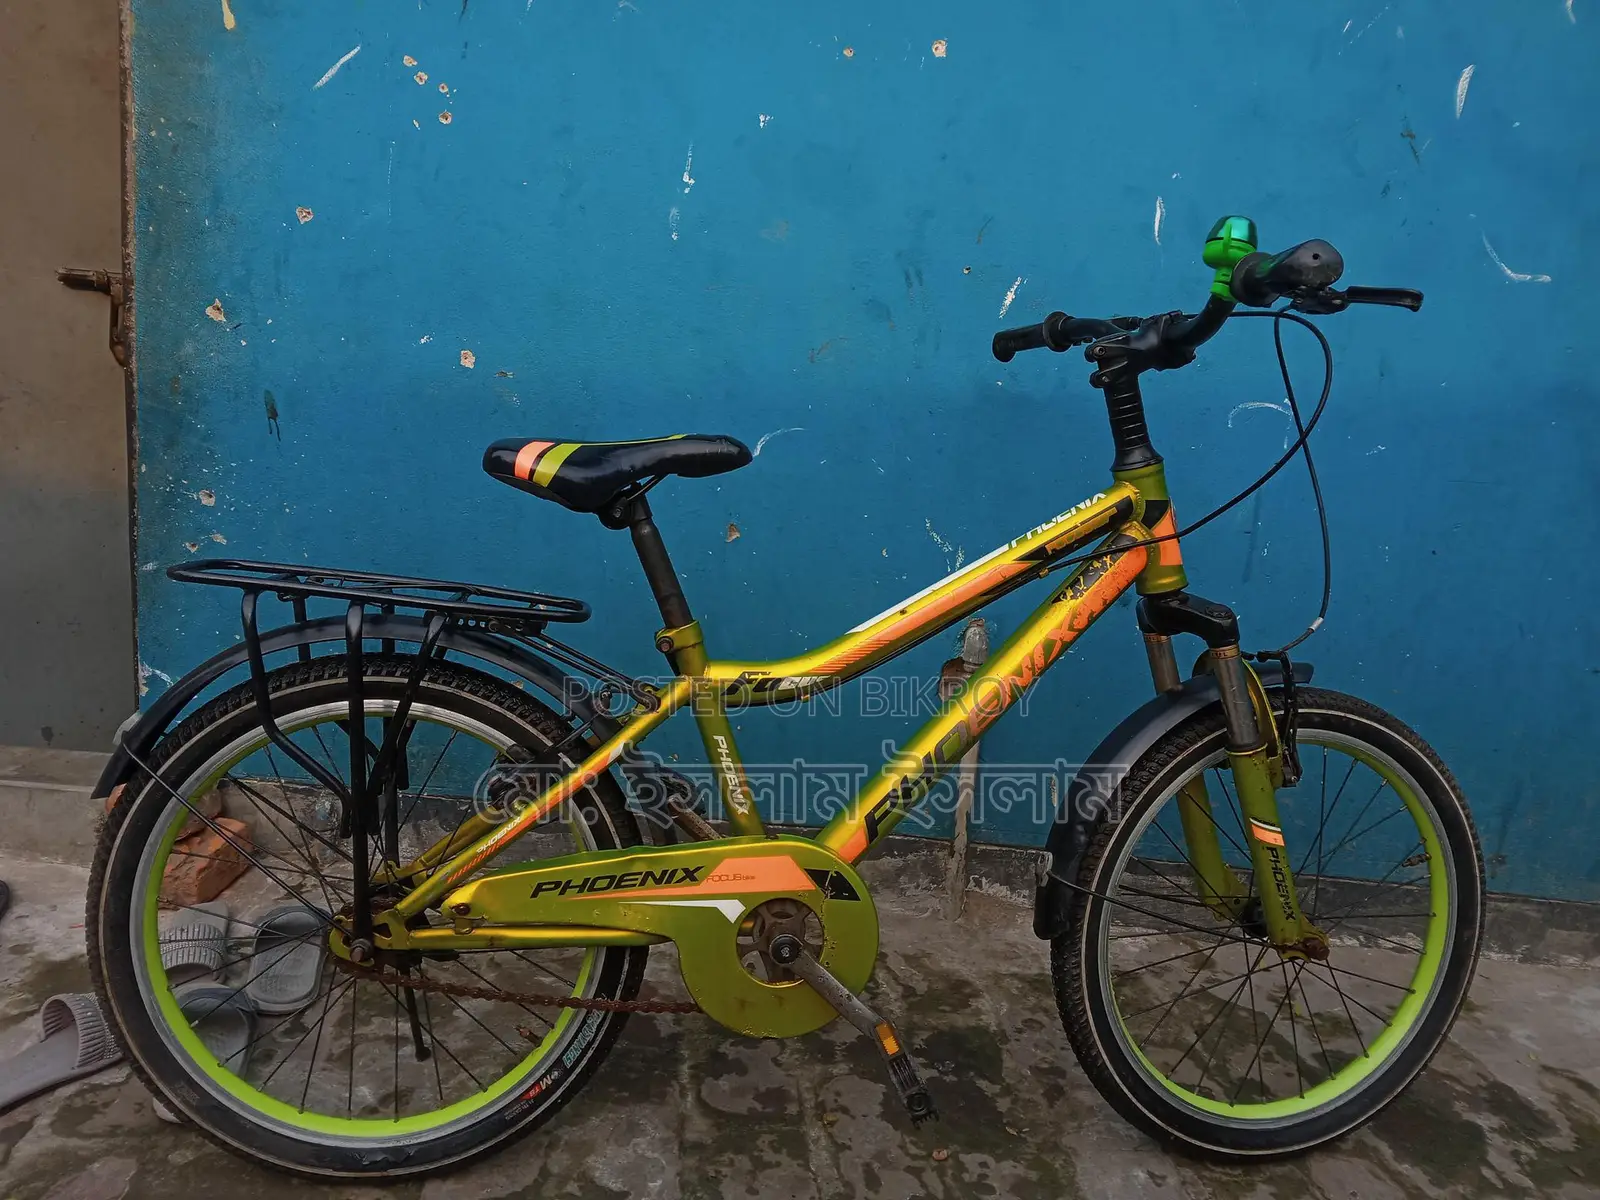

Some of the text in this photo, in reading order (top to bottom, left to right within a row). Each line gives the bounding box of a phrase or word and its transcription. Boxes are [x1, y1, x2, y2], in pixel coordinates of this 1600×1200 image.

[864, 608, 1079, 845] PHOENIX
[712, 735, 750, 815] PHOENIX
[476, 816, 522, 854] PHOENIX
[530, 865, 705, 899] PHOENIX
[1266, 846, 1296, 921] PHOENIX
